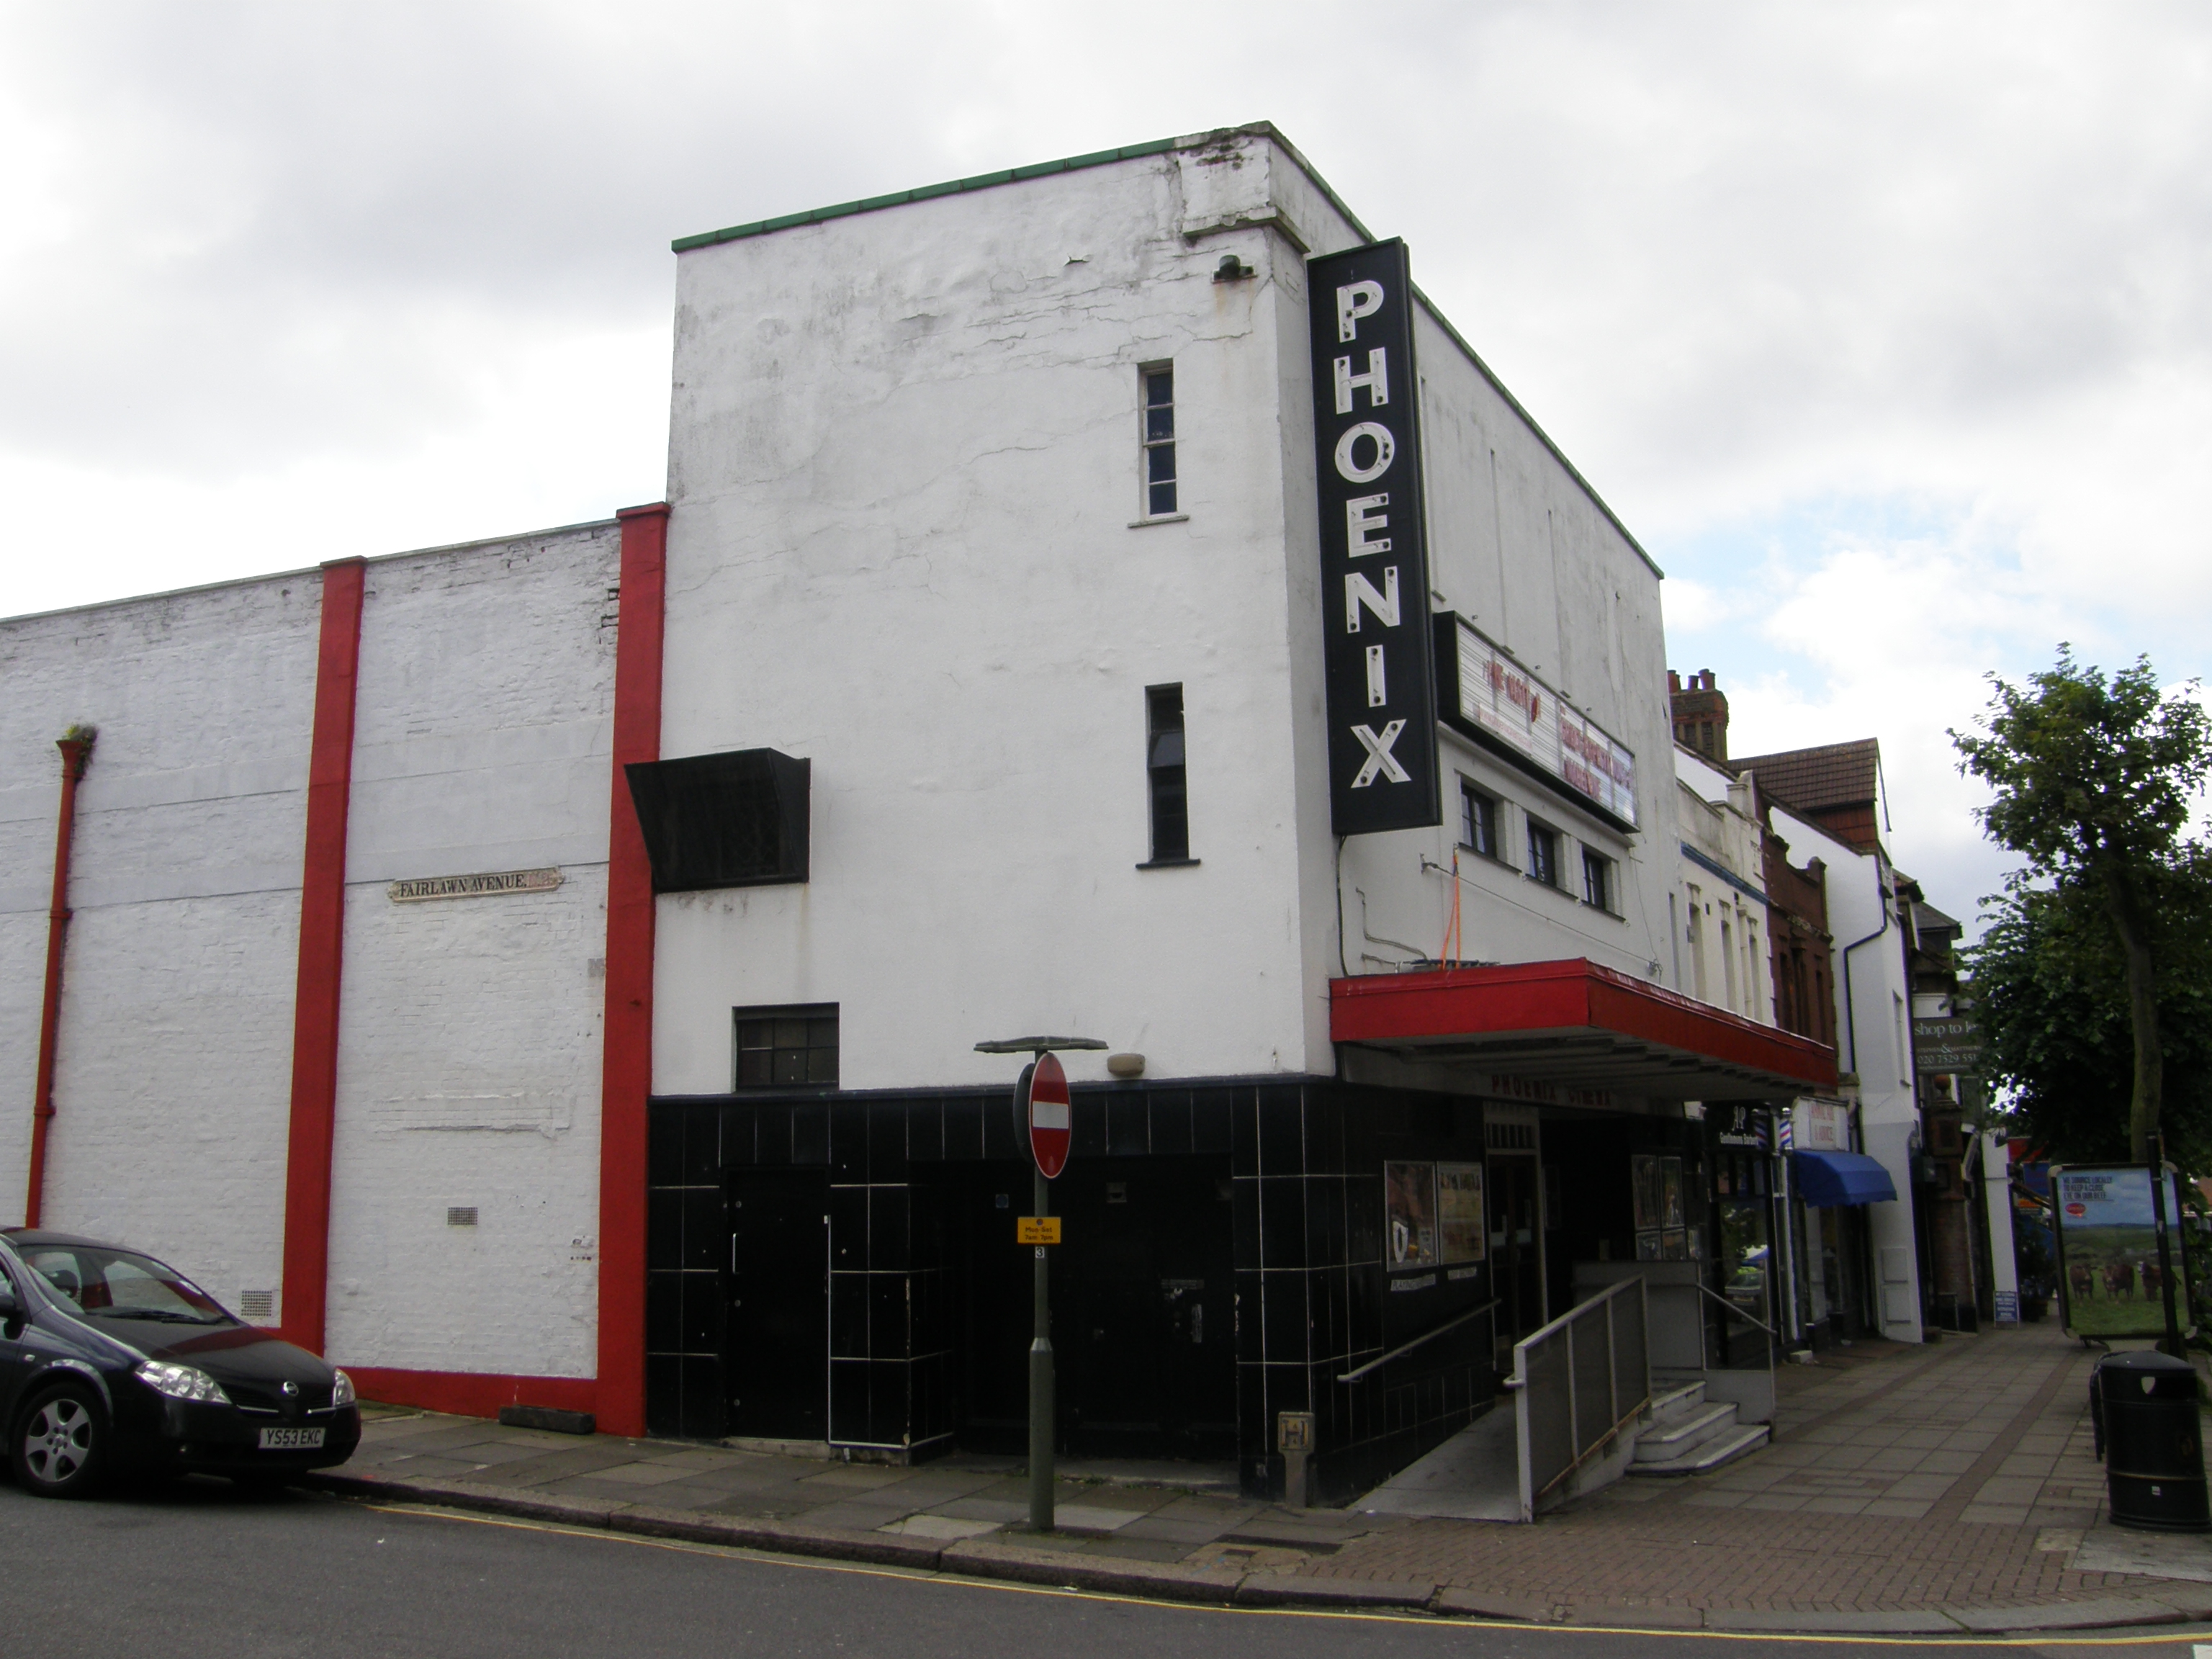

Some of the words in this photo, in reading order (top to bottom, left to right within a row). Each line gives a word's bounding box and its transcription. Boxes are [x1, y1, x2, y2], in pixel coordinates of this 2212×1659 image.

[1334, 279, 1412, 789] PHOENIX
[400, 878, 467, 897] FAIRLAWN
[1915, 1022, 1946, 1038] shop
[1948, 1023, 1962, 1034] to
[1917, 1055, 1935, 1064] 020
[1937, 1053, 1959, 1064] 7529
[1961, 1053, 1979, 1062] 551
[1491, 1074, 1556, 1101] PHOENIX
[1036, 1247, 1043, 1257] 3
[266, 1429, 298, 1444] YS53
[300, 1429, 321, 1444] EKC
